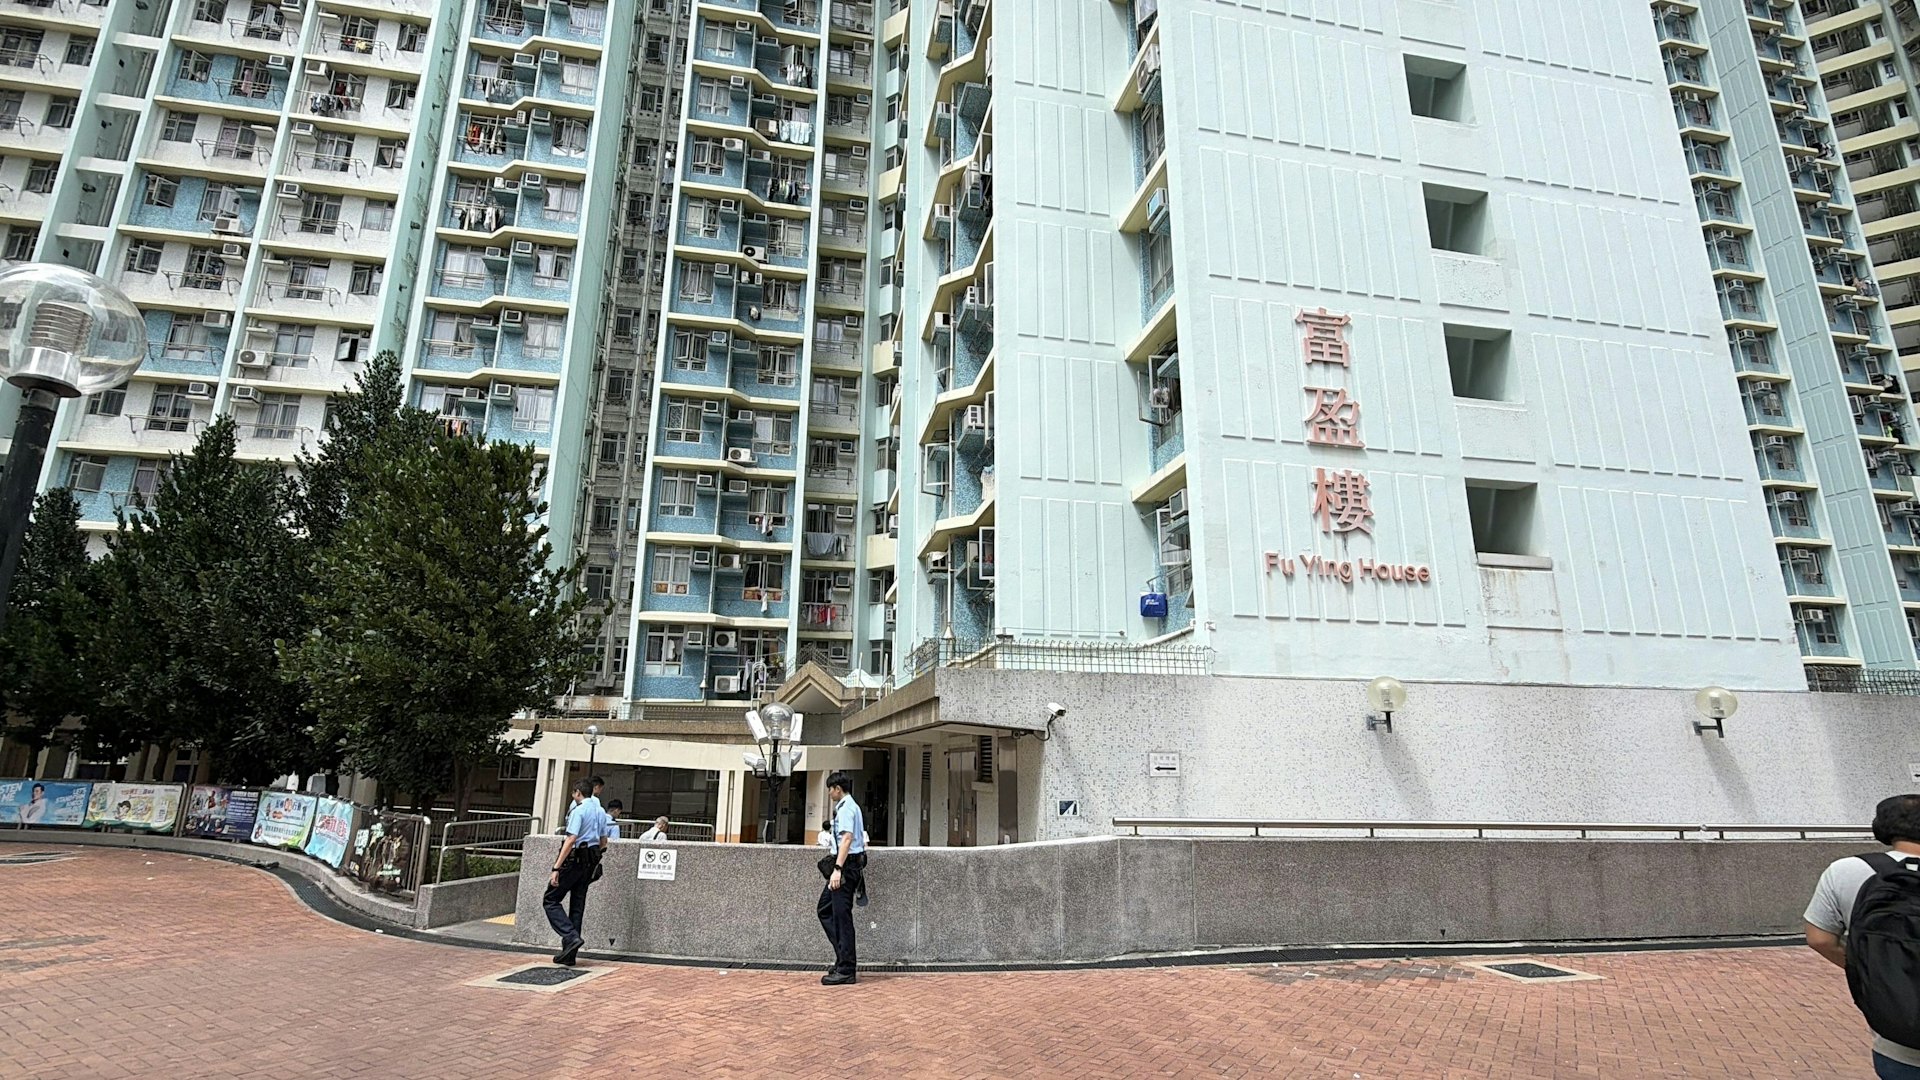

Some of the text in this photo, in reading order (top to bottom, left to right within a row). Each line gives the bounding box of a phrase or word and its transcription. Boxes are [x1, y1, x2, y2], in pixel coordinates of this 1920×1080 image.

[1295, 307, 1374, 535] 富盈樓
[1265, 551, 1431, 583] Fu Ying House
